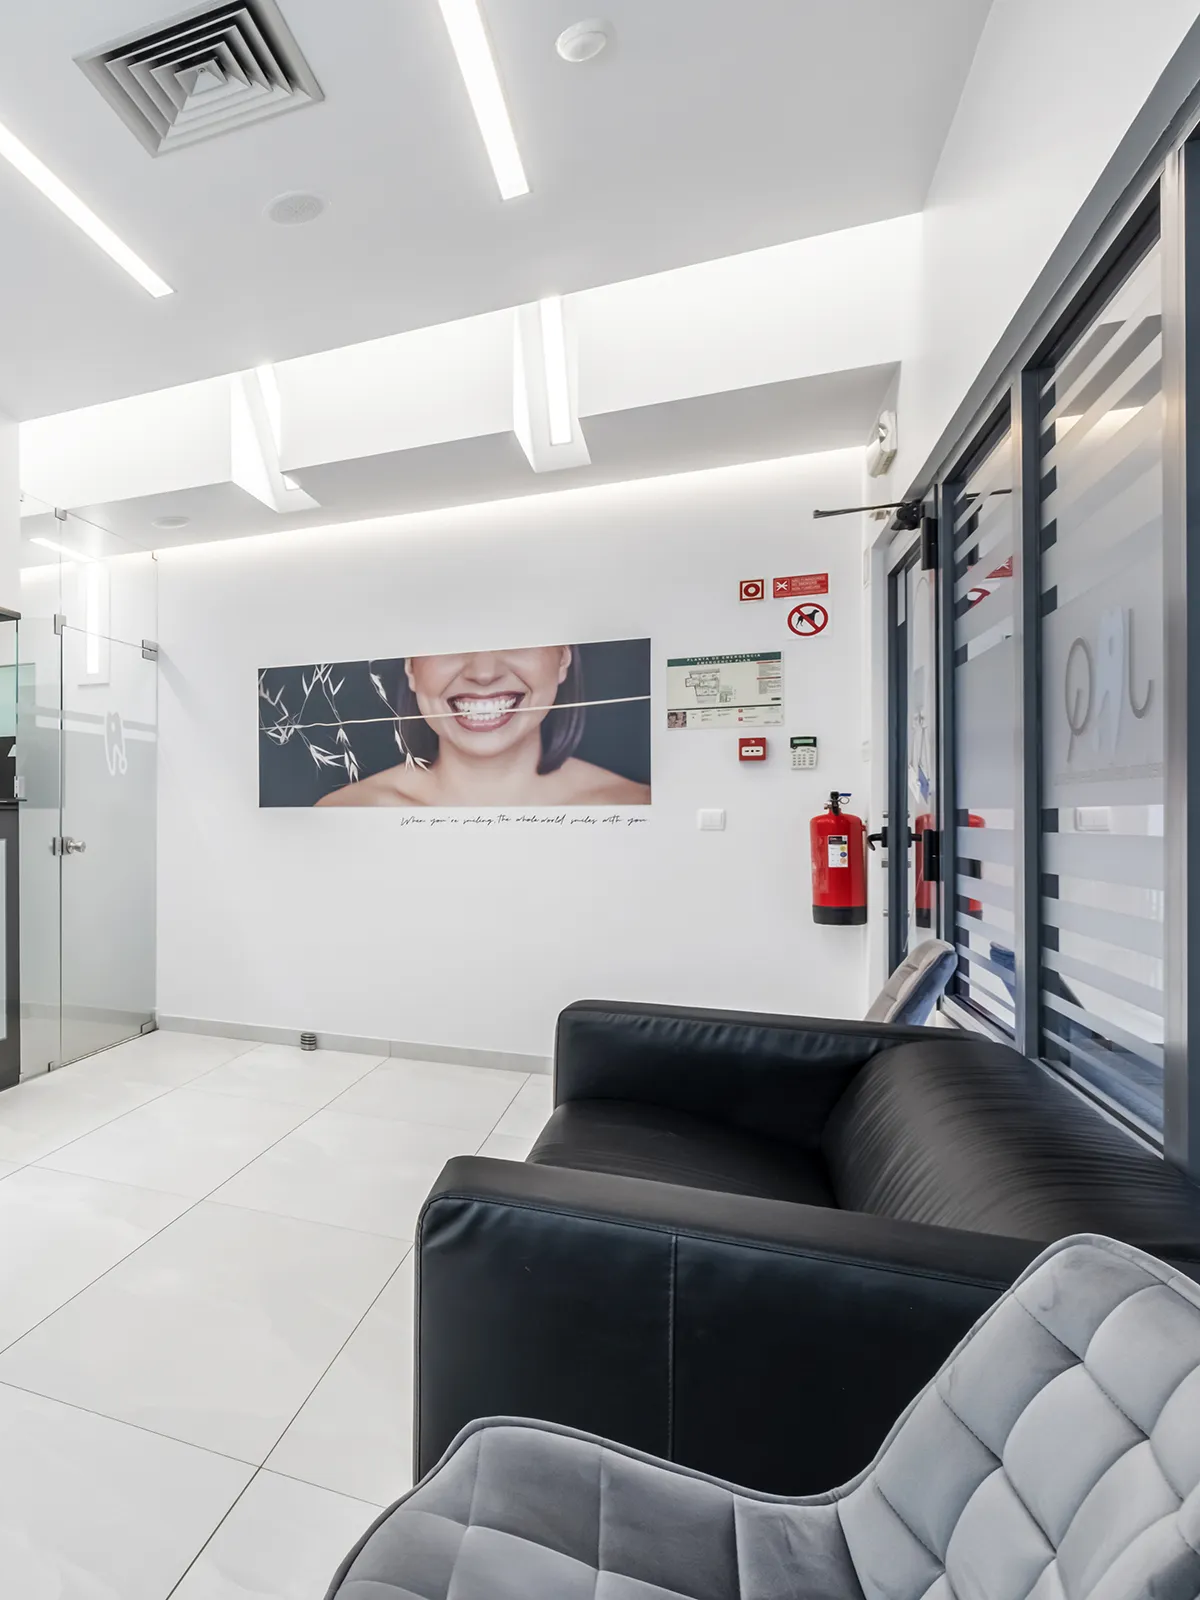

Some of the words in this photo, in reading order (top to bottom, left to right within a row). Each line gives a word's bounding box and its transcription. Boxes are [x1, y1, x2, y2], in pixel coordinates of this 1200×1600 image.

[400, 815, 425, 826] When
[540, 813, 567, 825] world
[569, 815, 597, 825] smiles
[602, 814, 622, 825] with
[627, 817, 648, 827] you
